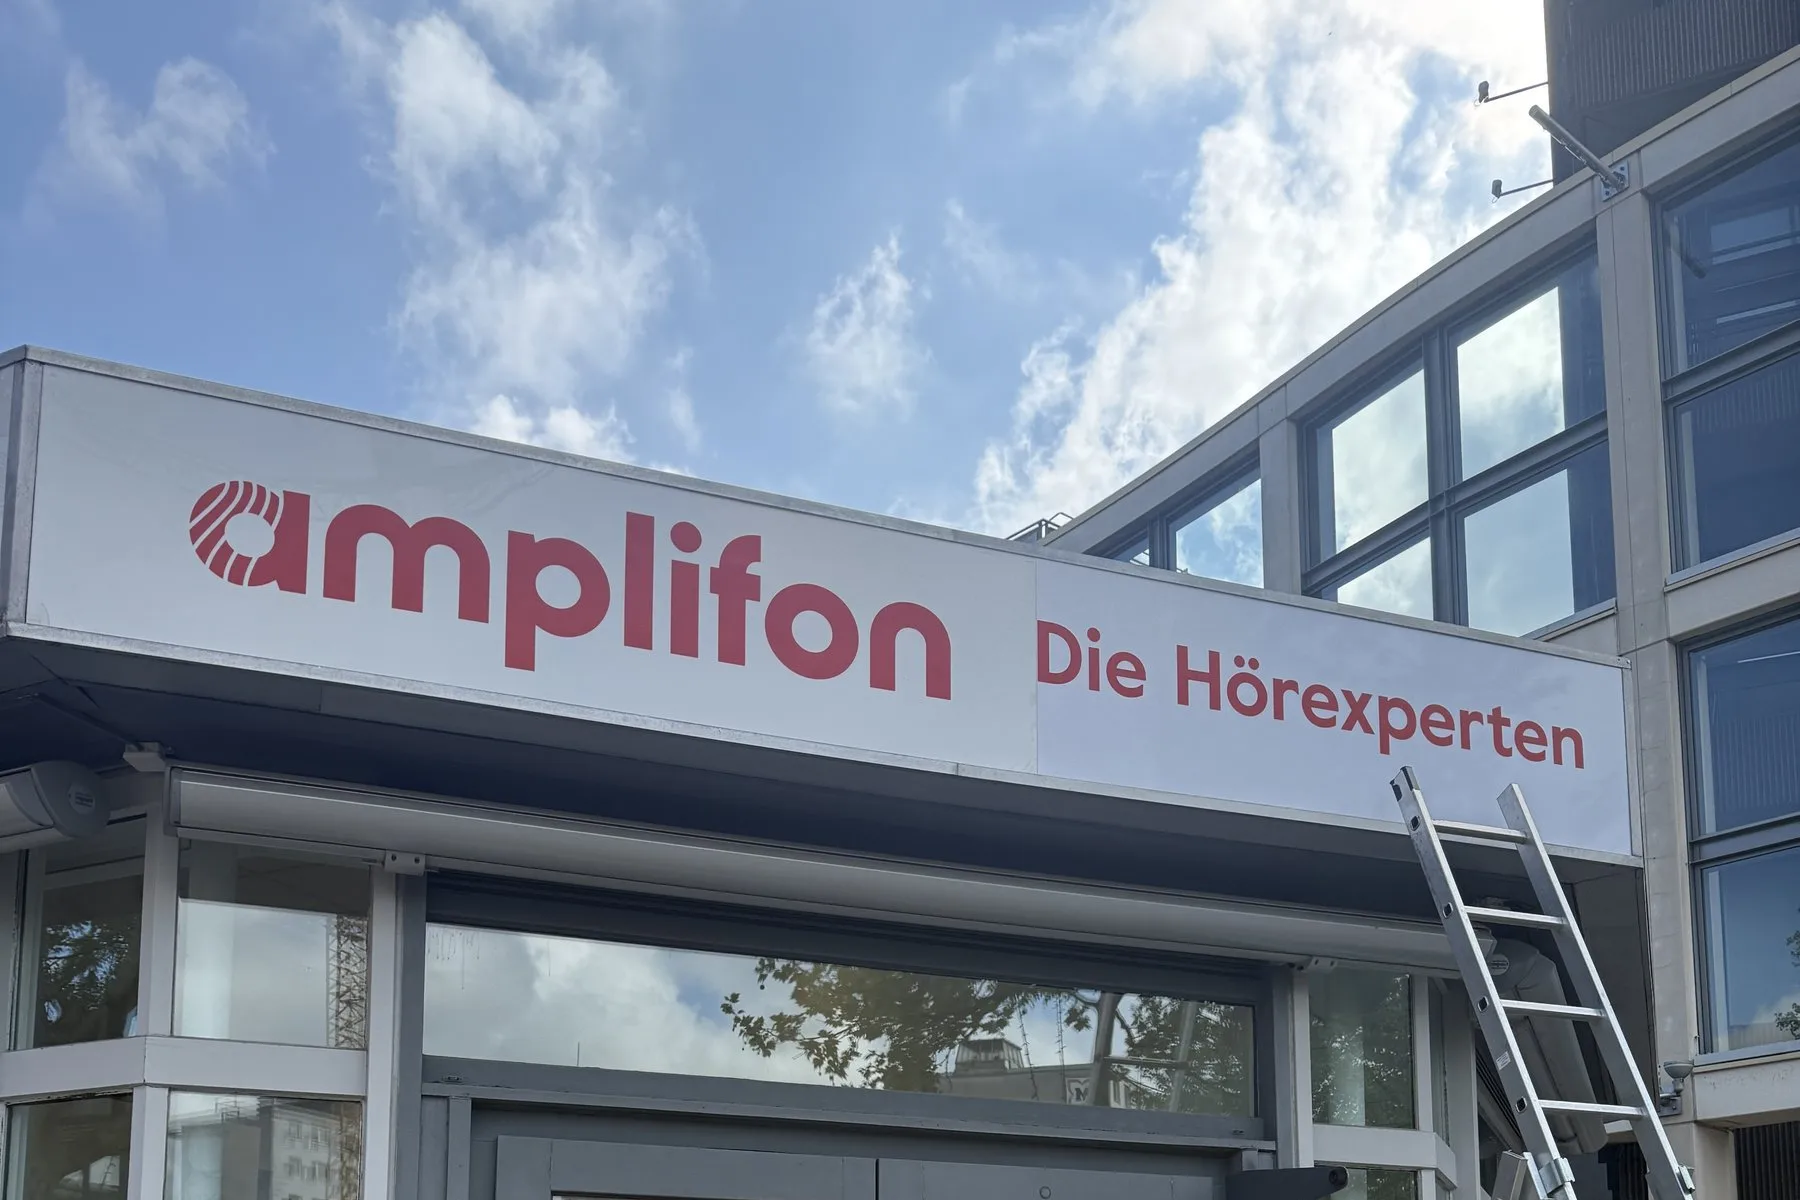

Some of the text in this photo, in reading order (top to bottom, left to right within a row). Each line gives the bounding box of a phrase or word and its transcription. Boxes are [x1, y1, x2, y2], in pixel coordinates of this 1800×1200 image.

[189, 480, 952, 701] amplifon
[1037, 621, 1585, 770] Die Hörexperten
